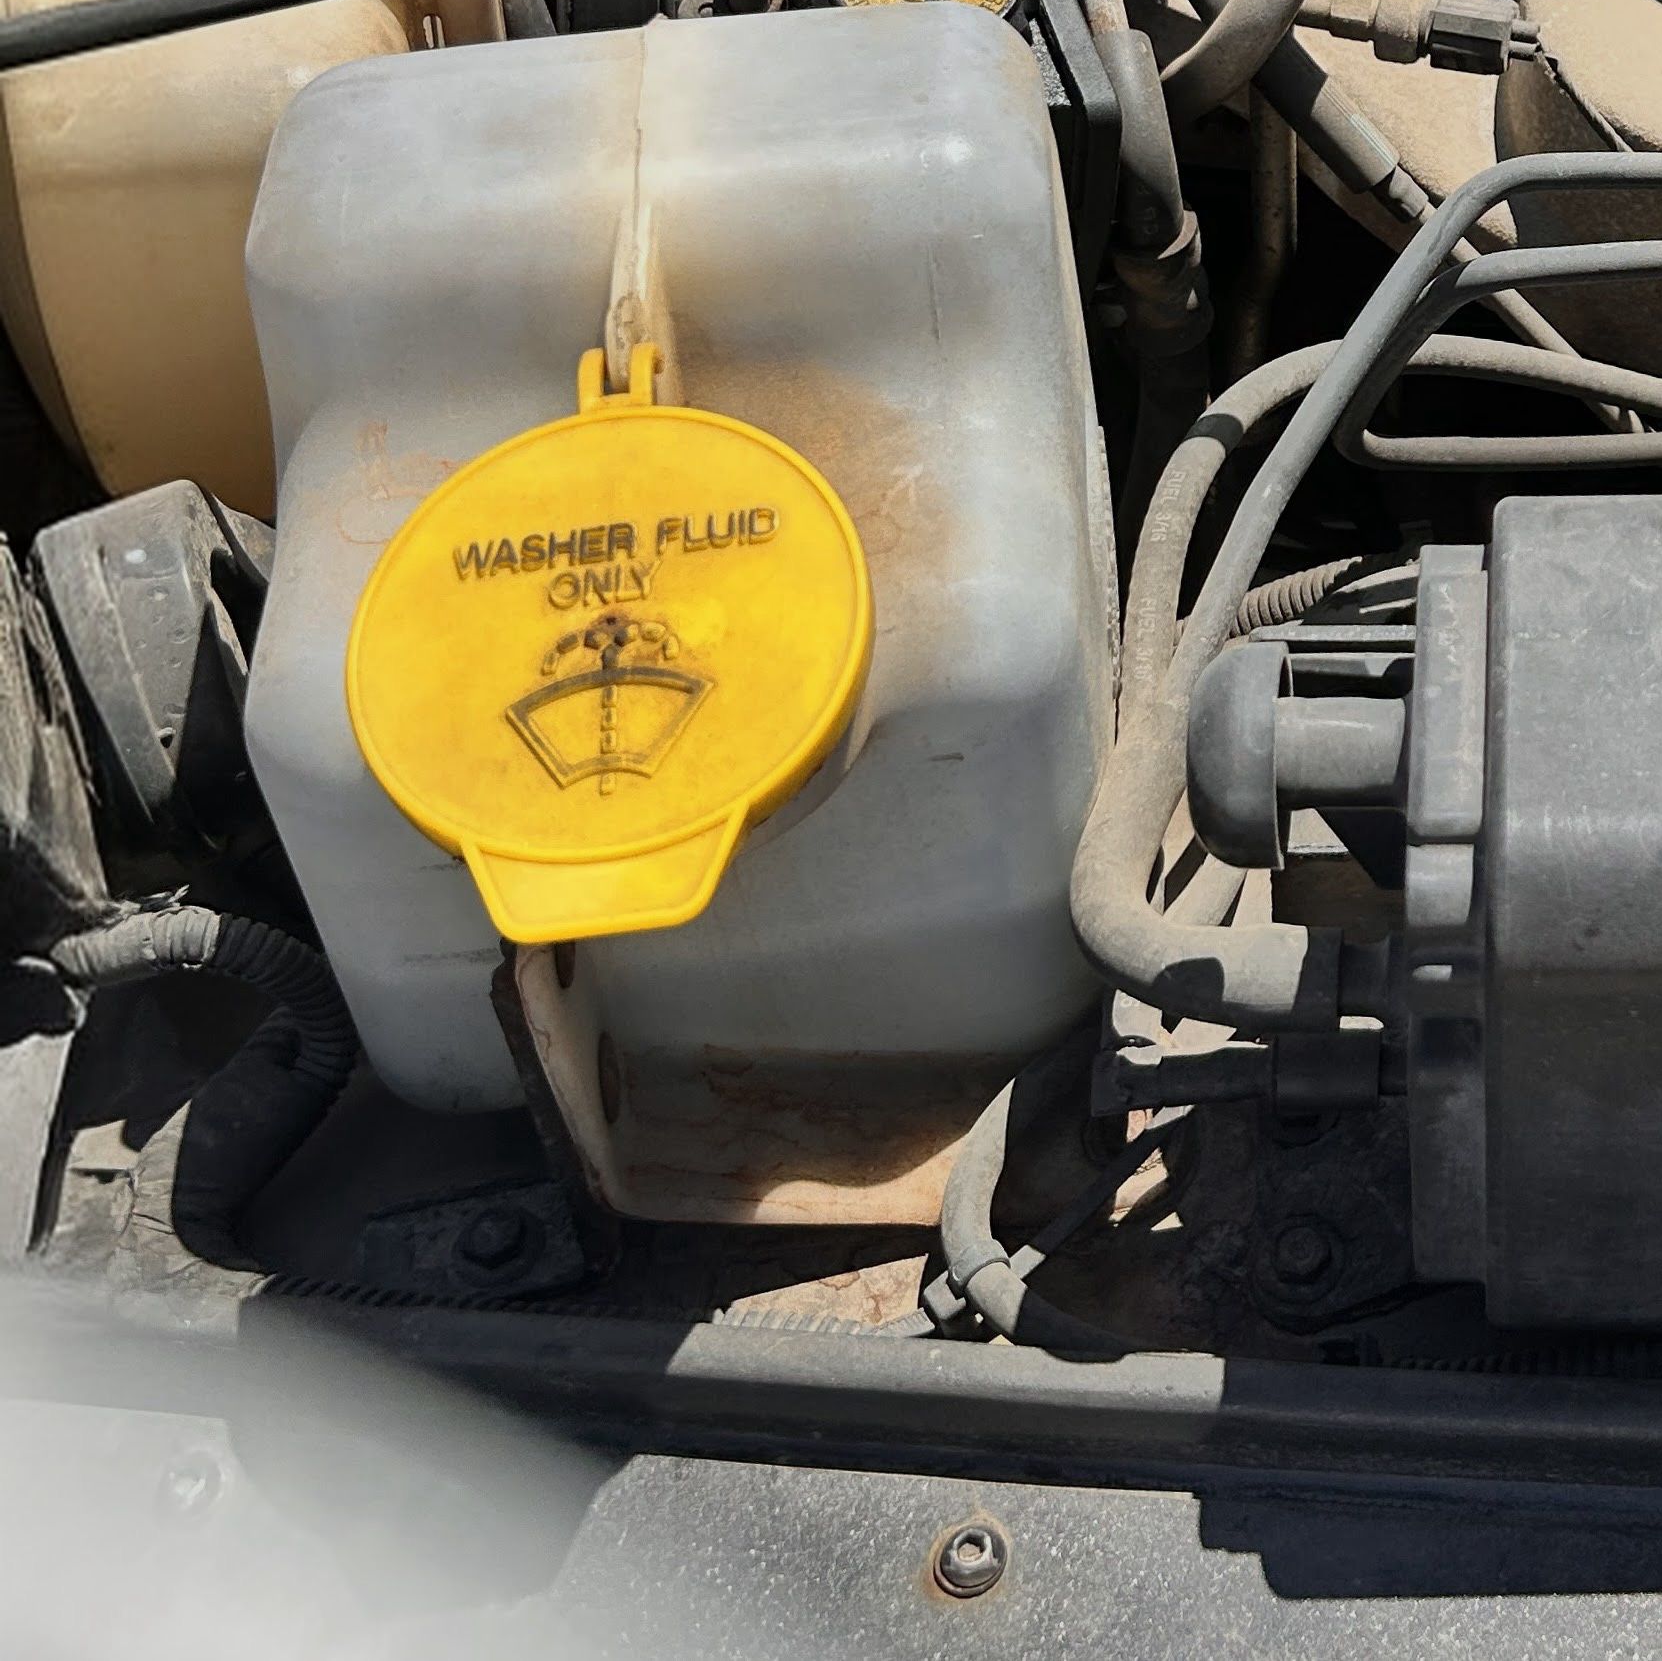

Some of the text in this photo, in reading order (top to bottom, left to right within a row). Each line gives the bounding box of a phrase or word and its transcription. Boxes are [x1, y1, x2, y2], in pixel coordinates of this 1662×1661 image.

[1160, 470, 1187, 506] FUEL
[453, 507, 779, 581] WASHER FLUID
[548, 559, 664, 610] ONLY
[1137, 596, 1157, 638] FUEL
